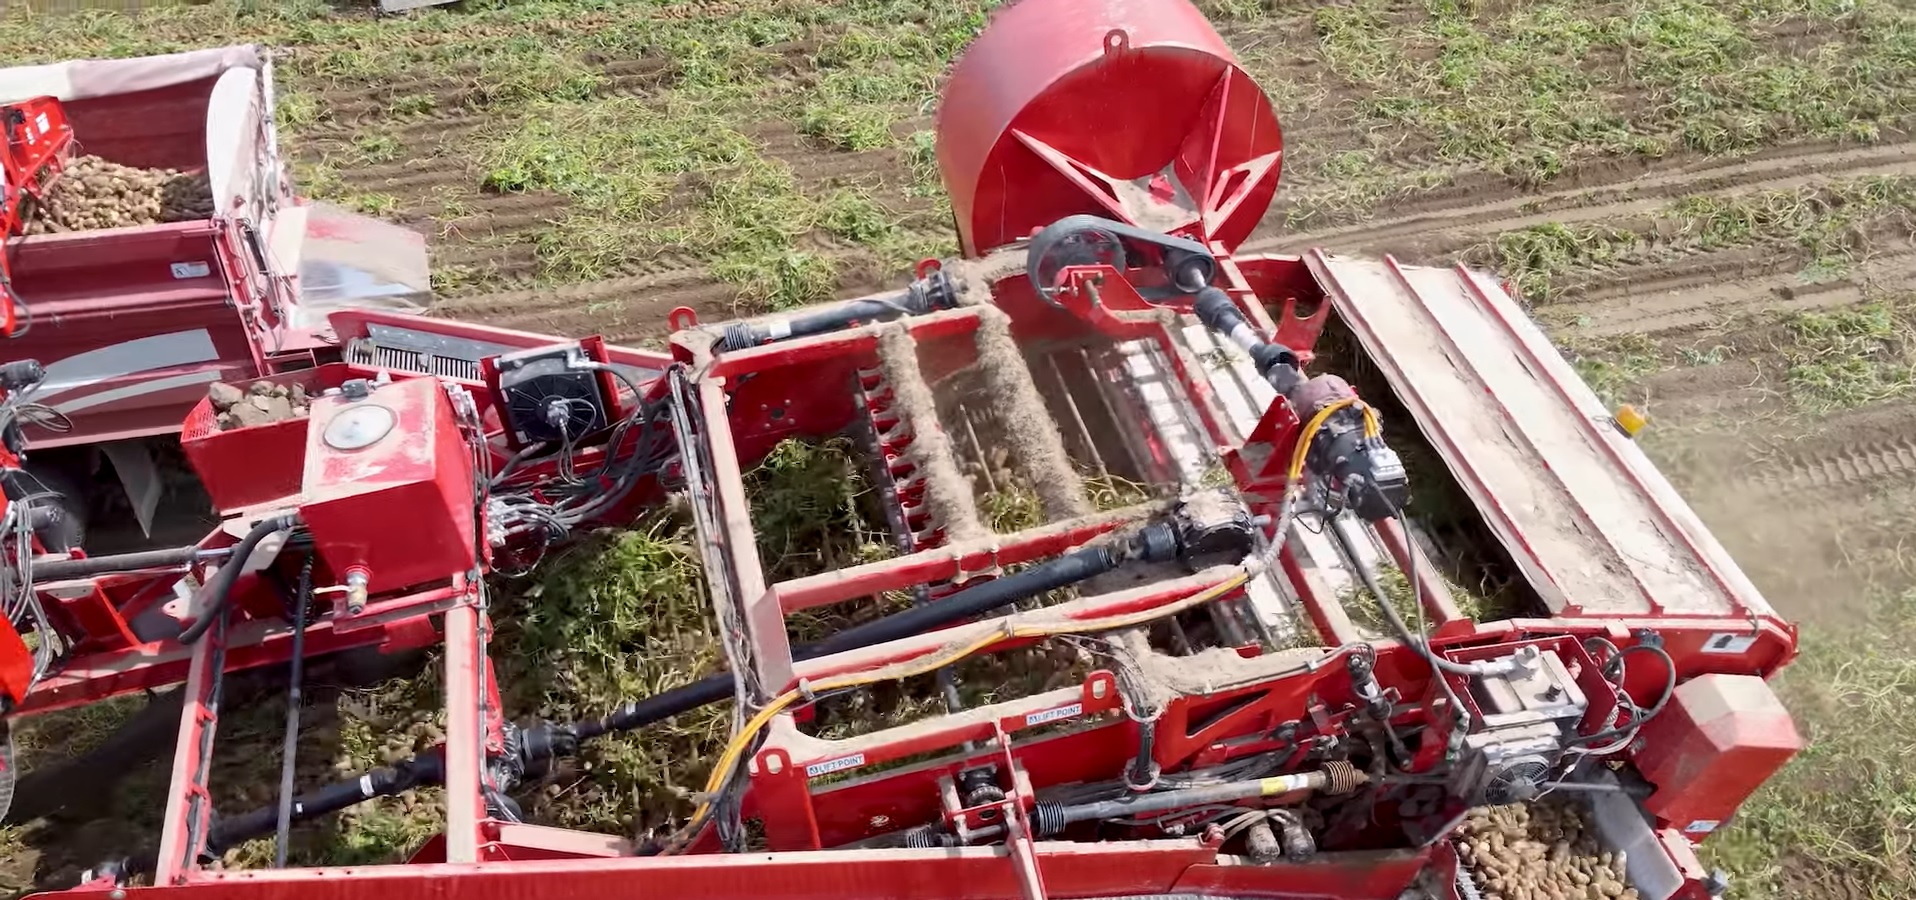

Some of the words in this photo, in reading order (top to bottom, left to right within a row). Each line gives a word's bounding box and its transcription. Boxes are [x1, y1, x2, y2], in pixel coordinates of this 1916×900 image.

[1037, 711, 1055, 721] LIFT
[1056, 706, 1079, 717] POINT
[819, 762, 836, 773] LIFT
[837, 756, 862, 767] POINT
